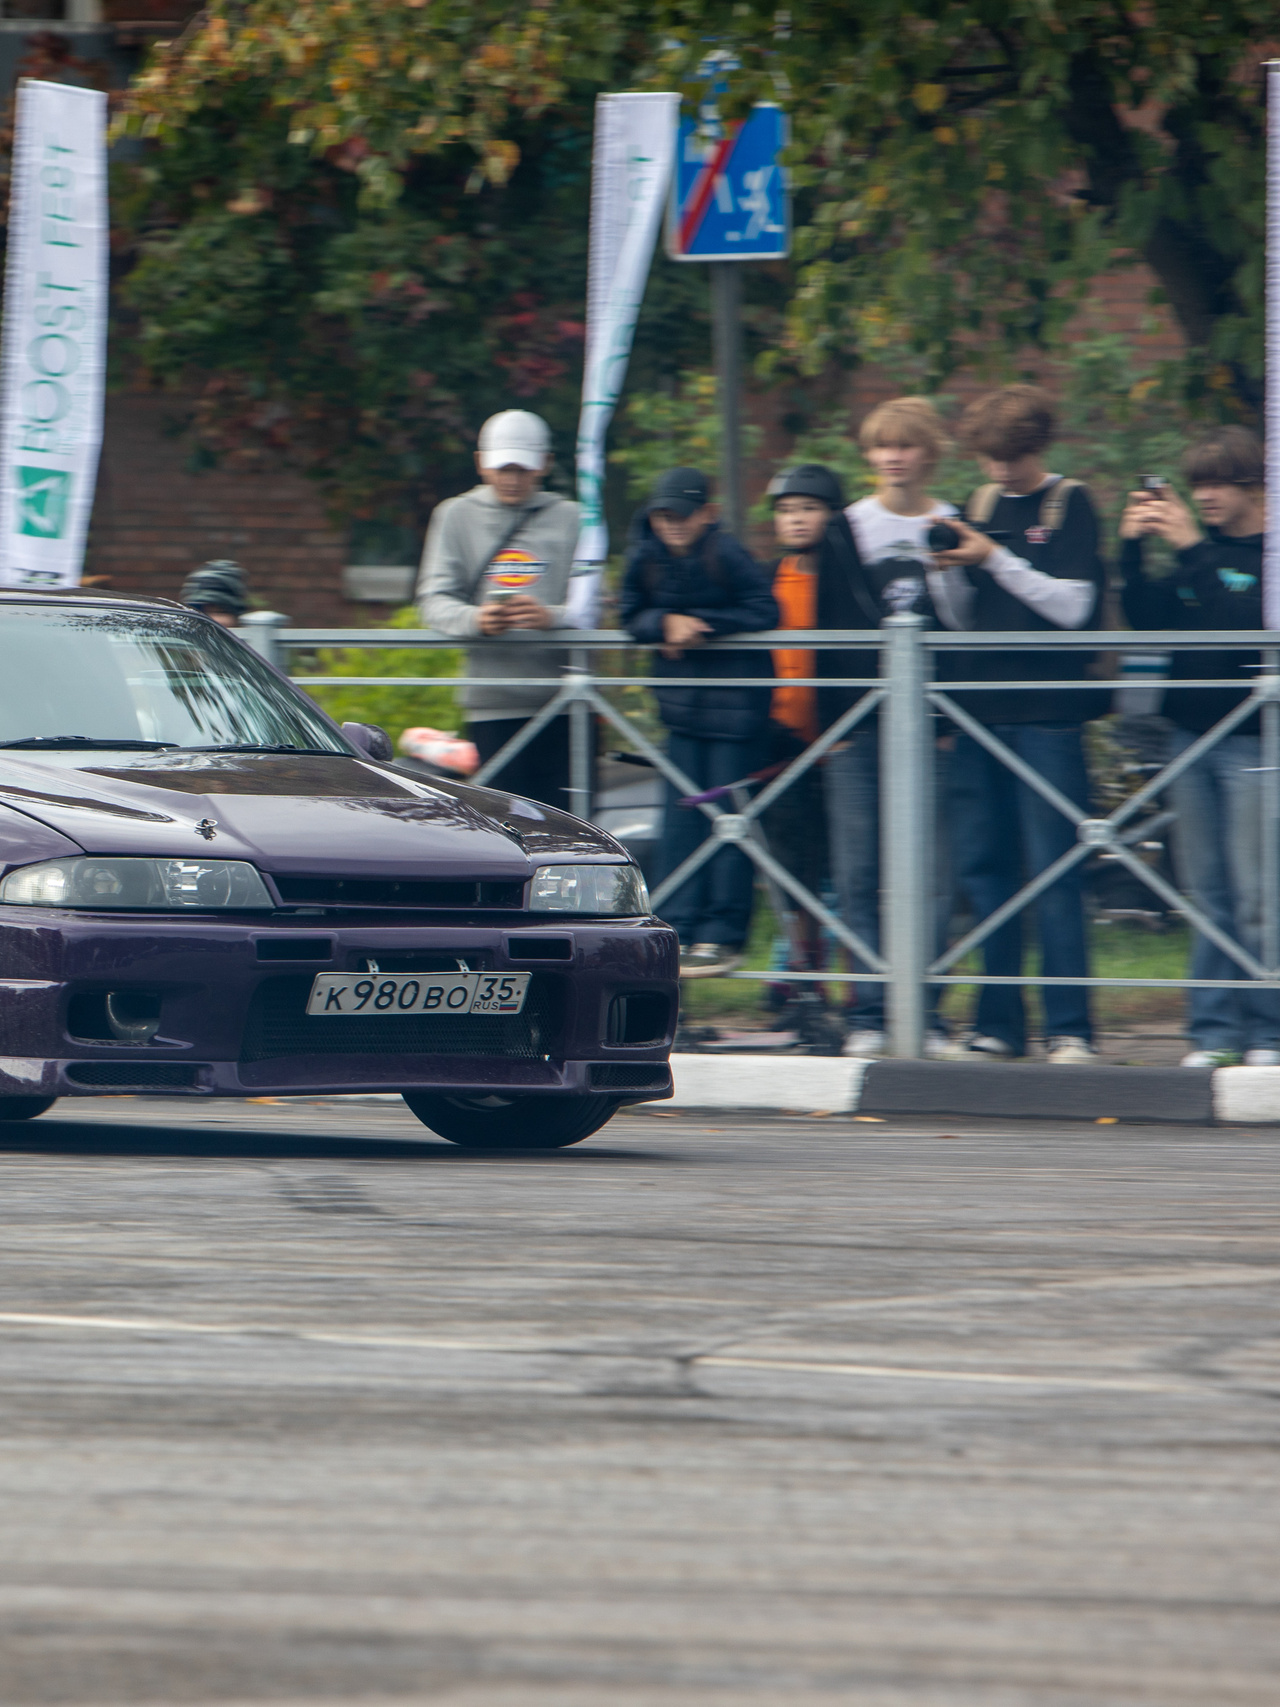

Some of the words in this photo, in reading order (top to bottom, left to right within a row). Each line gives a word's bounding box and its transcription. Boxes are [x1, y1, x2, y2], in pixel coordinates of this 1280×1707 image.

[16, 270, 86, 453] BOOST
[479, 977, 517, 1001] 35
[472, 1001, 499, 1010] RUS
